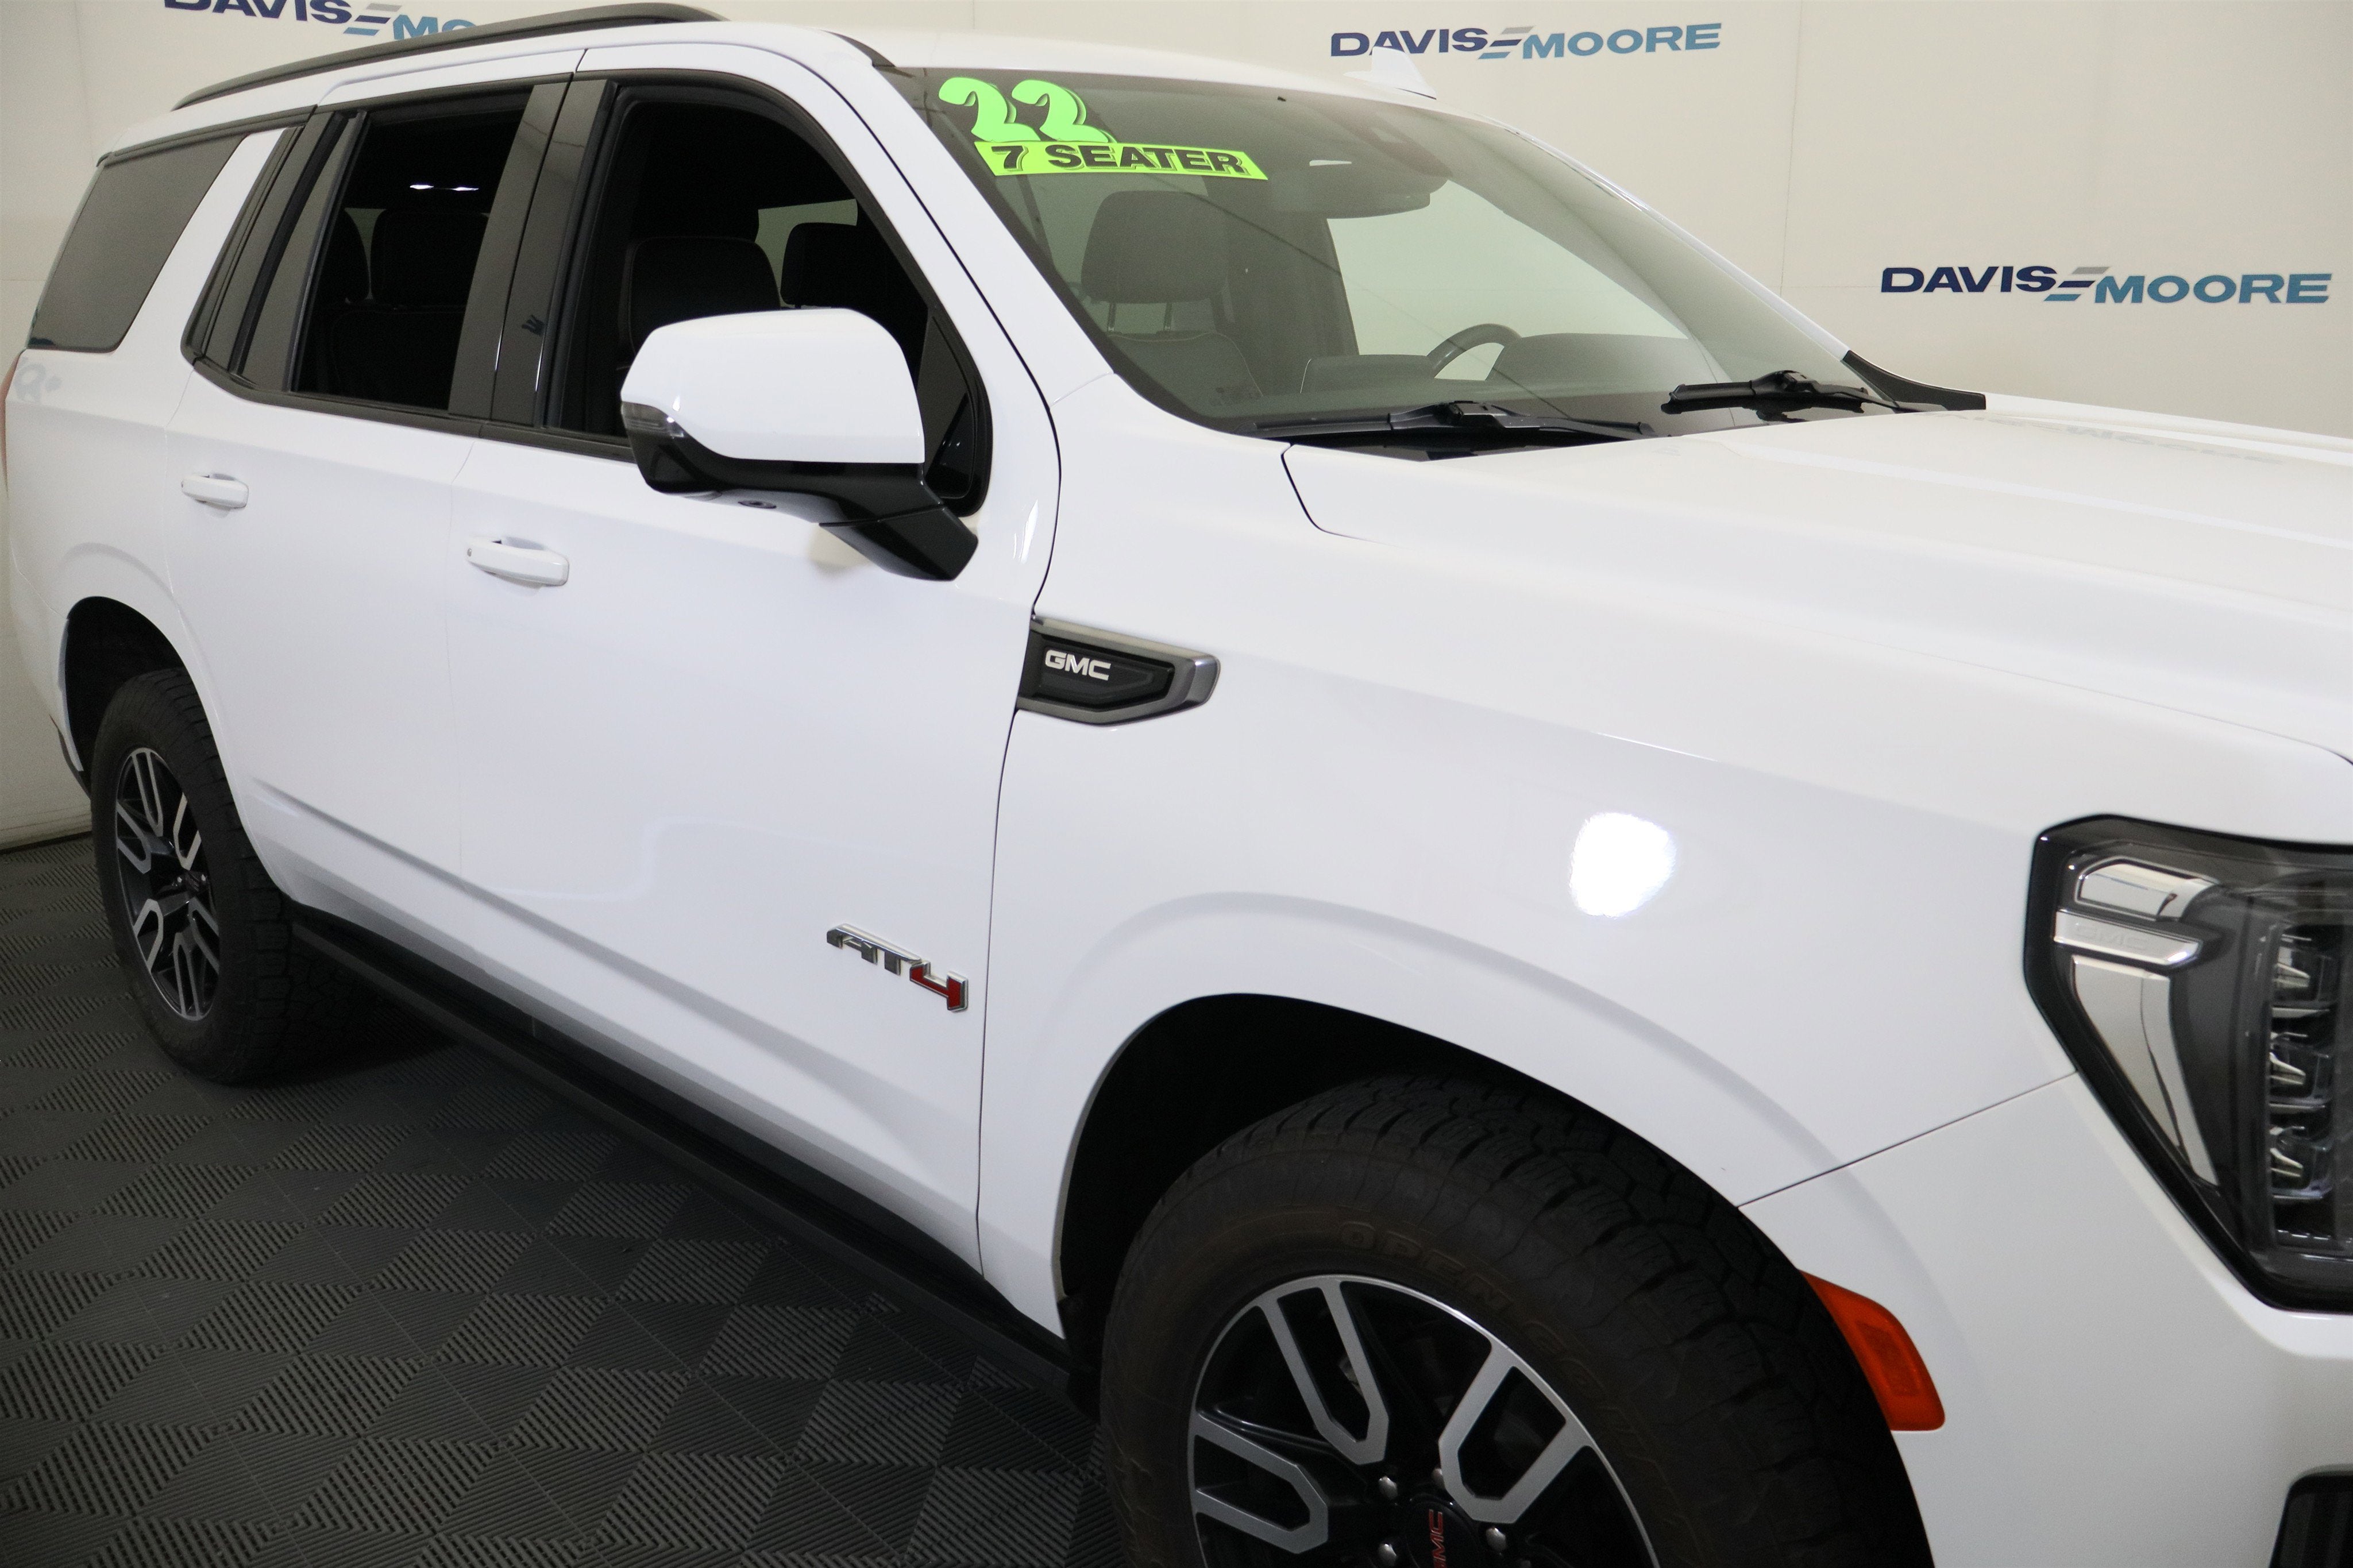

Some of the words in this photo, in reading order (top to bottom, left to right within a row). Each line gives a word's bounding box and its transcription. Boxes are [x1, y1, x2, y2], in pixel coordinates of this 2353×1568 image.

[1330, 28, 1489, 56] DAVIS
[1522, 23, 1722, 59] MOORE
[939, 77, 1118, 143] 22
[991, 145, 1029, 170] 7
[1045, 144, 1251, 176] SEATER
[1881, 265, 2058, 293] DAVIS
[2094, 273, 2332, 304] MOORE
[1044, 649, 1112, 681] GMC
[827, 922, 969, 1013] AT4
